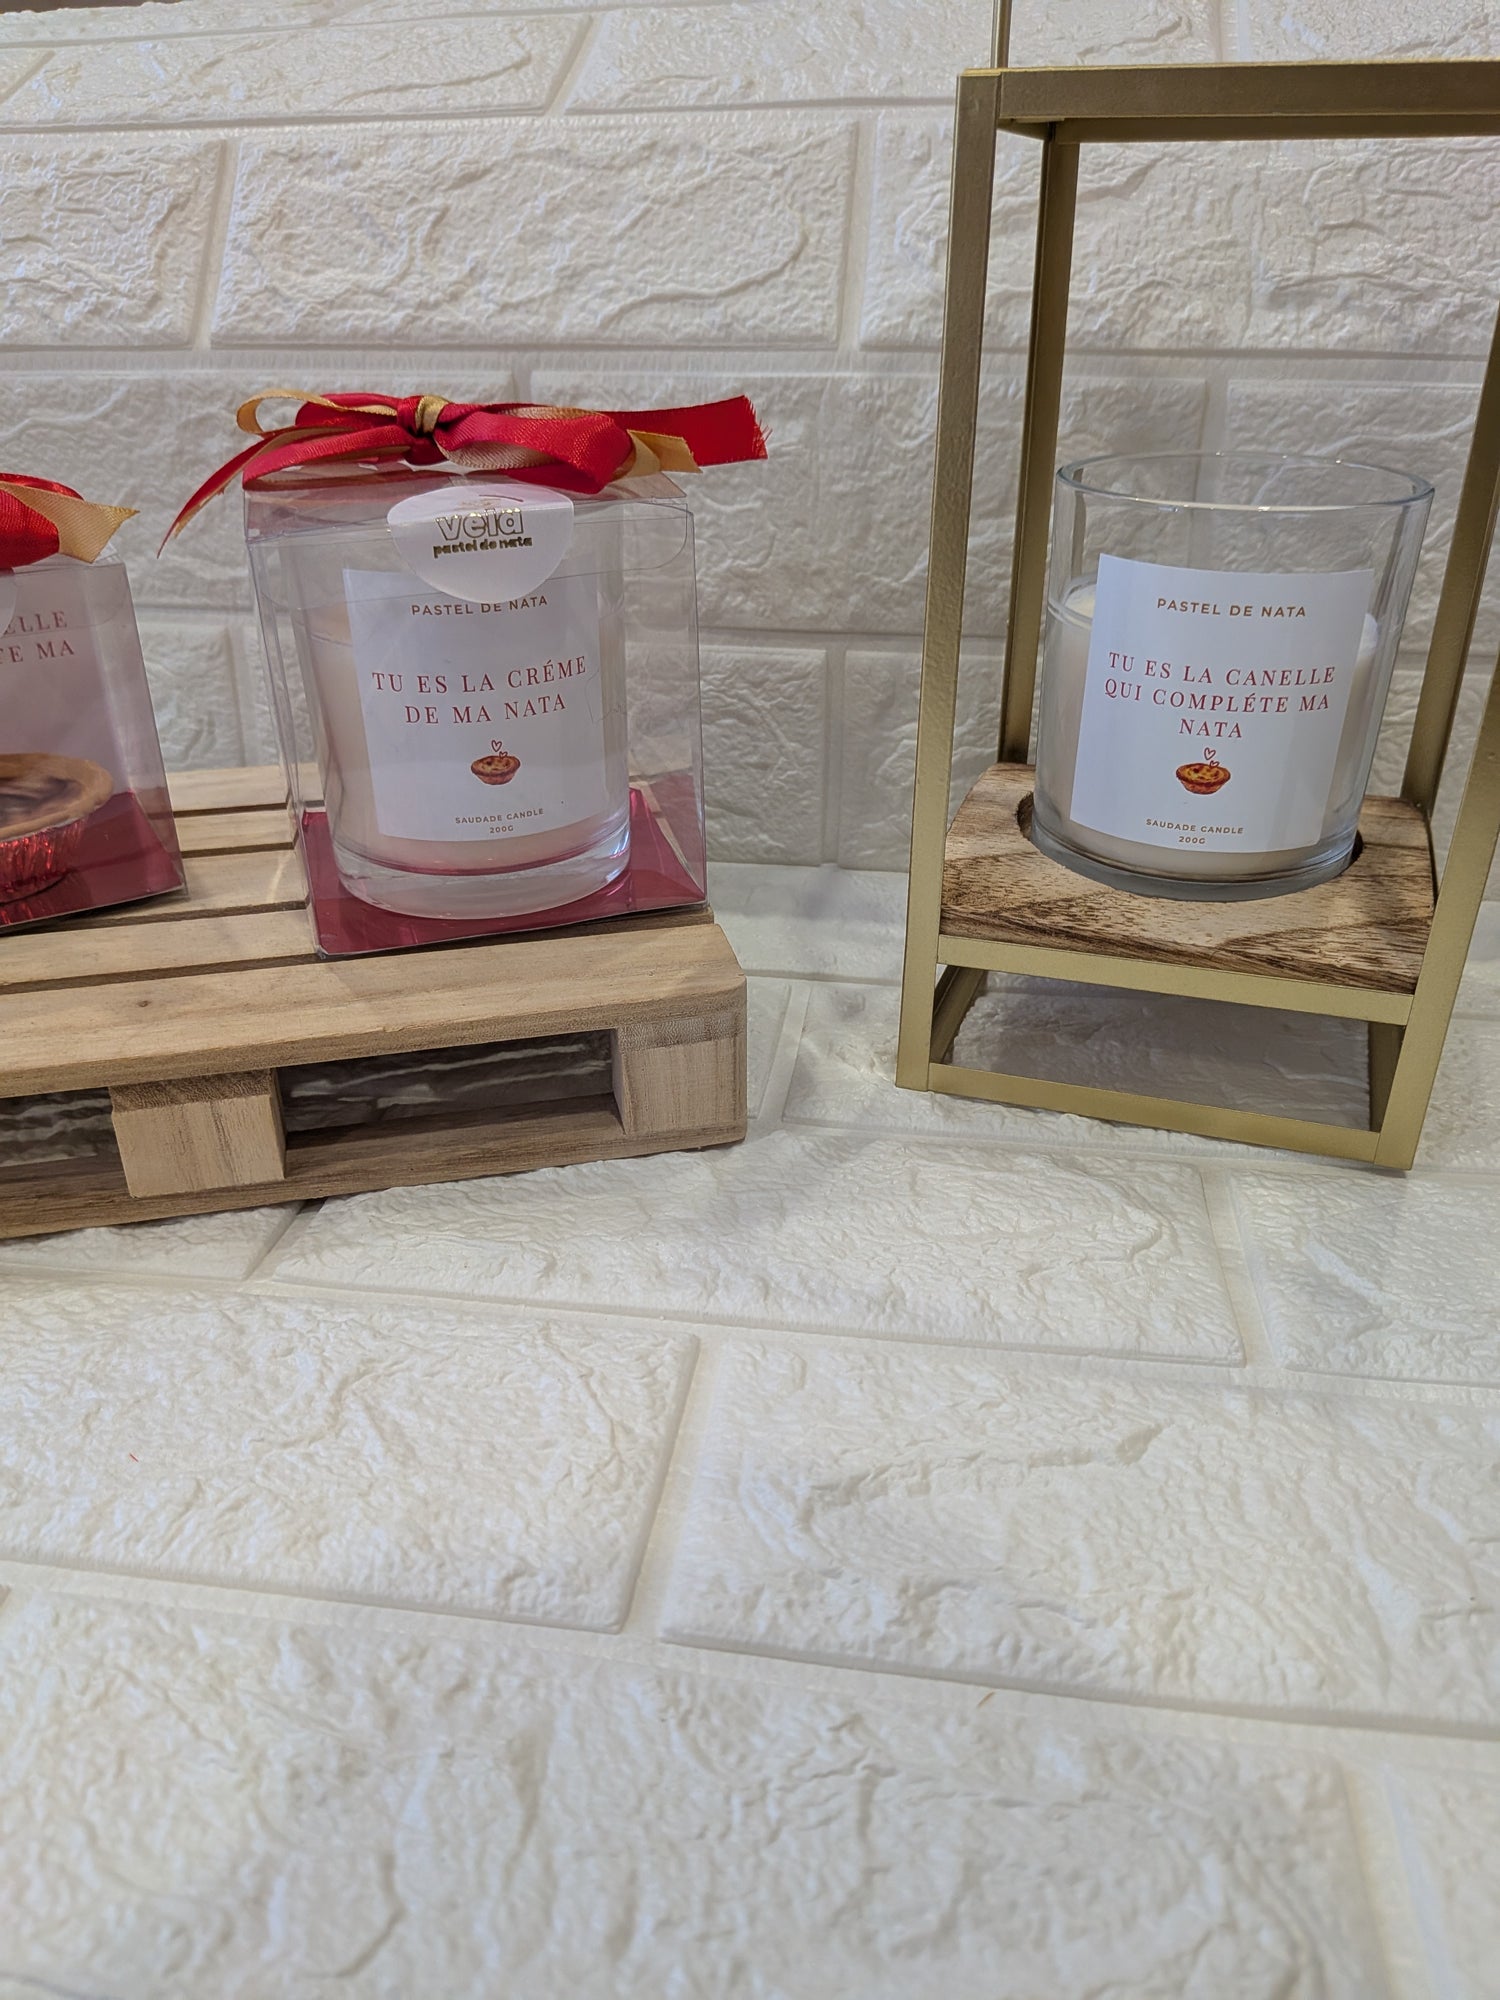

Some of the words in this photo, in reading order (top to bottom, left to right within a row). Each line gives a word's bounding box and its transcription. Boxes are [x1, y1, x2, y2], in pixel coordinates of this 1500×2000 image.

[433, 540, 478, 558] pastel
[480, 539, 498, 551] de
[500, 536, 533, 549] nata
[411, 603, 474, 616] PASTEL
[480, 603, 502, 613] DE
[509, 595, 548, 611] NATA
[1157, 598, 1221, 615] PASTEL
[1229, 604, 1254, 617] DE
[1261, 606, 1307, 618] NATA
[36, 639, 75, 660] MA
[371, 672, 404, 693] TU
[417, 675, 448, 694] ES
[461, 673, 496, 693] LA
[507, 656, 587, 689] CRÉME
[1109, 651, 1135, 672] TU
[1144, 660, 1172, 679] ES
[1183, 665, 1213, 684] LA
[1225, 666, 1336, 687] CANELLE
[1104, 678, 1142, 701] QUI
[1152, 688, 1289, 713] COMPLÉTE
[1298, 695, 1330, 712] MA
[404, 705, 439, 724] DE
[452, 706, 492, 724] MA
[503, 693, 567, 720] NATA
[1178, 718, 1243, 739] NATA
[455, 814, 503, 824] SAUDADE
[506, 808, 545, 820] CANDLE
[1145, 818, 1198, 832] SAUDADE
[1200, 825, 1245, 834] CANDLE
[489, 825, 515, 834] 200G
[1178, 836, 1207, 845] 200G
